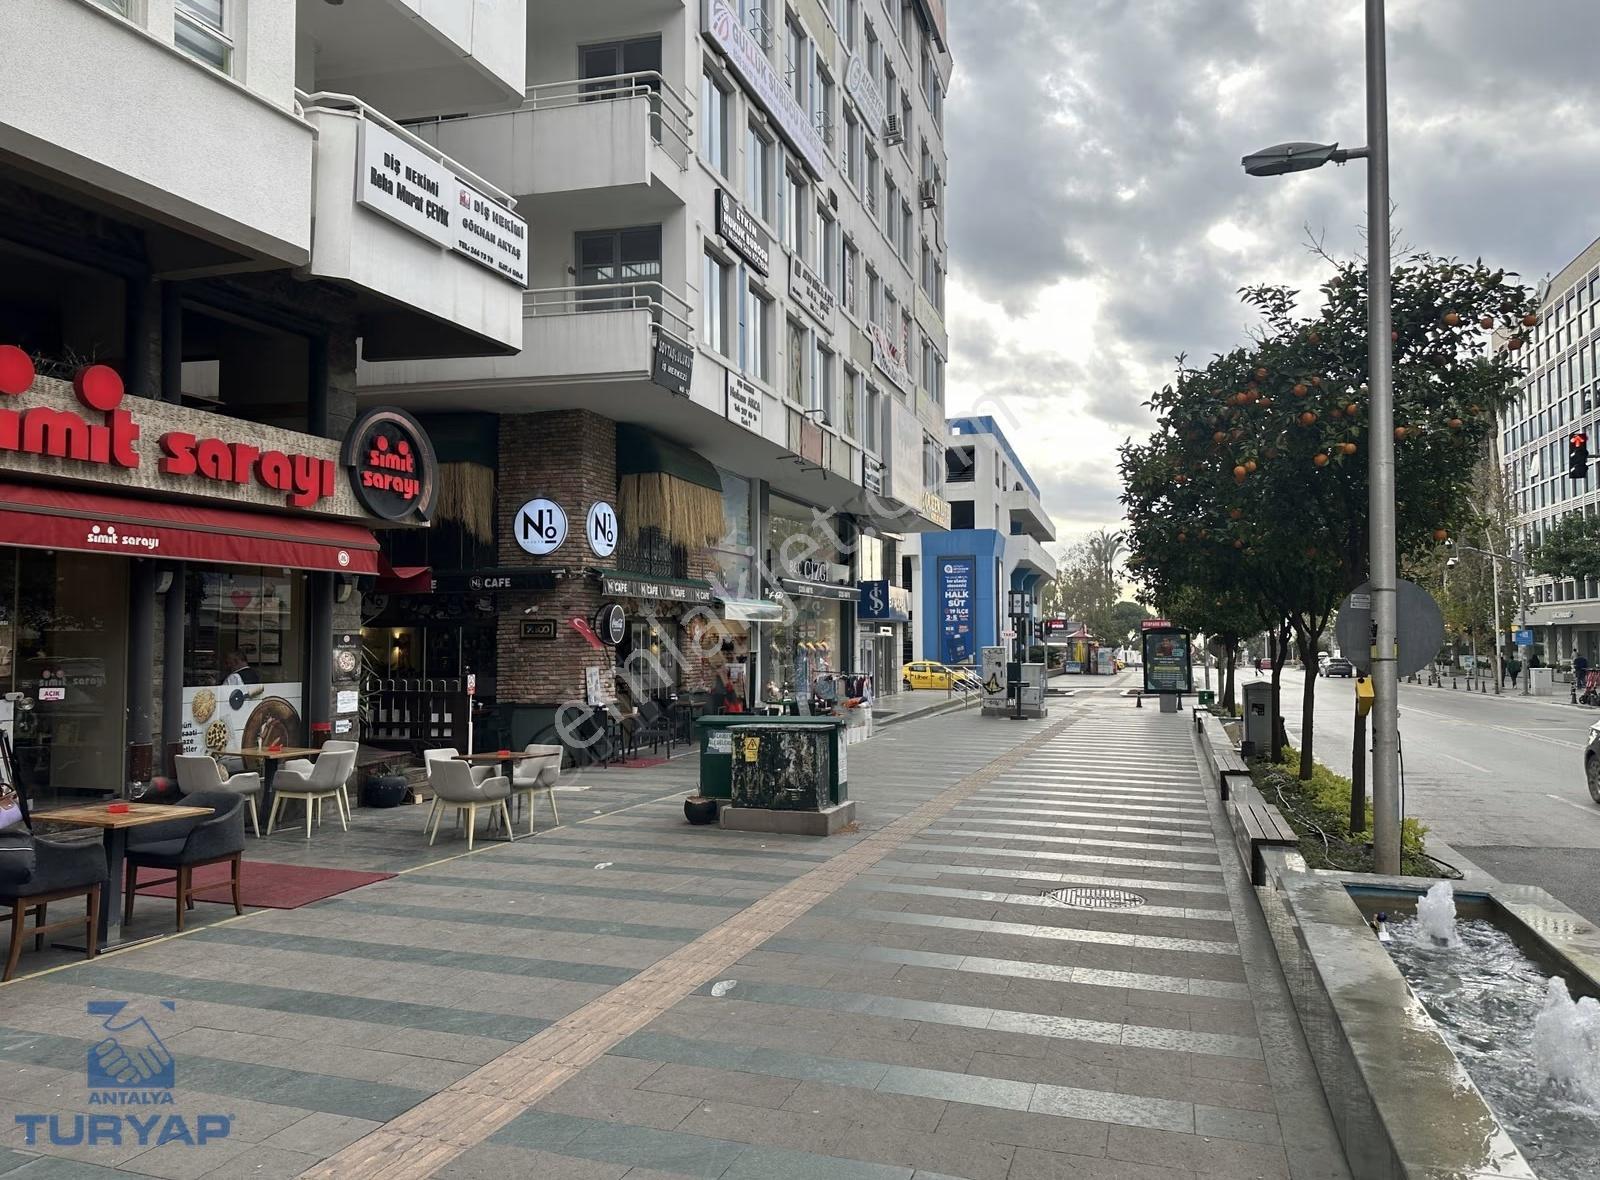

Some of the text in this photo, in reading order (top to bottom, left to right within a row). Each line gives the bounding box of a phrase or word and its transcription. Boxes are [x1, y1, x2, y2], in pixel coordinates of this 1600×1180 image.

[384, 152, 439, 197] DİŞ HEKİMİ
[370, 166, 393, 195] Reha
[397, 182, 423, 212] Murat
[426, 199, 449, 227] ÇEVİK
[474, 198, 490, 221] DİŞ
[492, 211, 524, 239] HEKİMİ
[723, 211, 745, 241] HUKUK
[737, 208, 757, 237] ETKİN
[462, 217, 521, 260] GÖKHAN AKTAŞ
[667, 365, 687, 381] MERKEZİ
[0, 345, 335, 507] imit sarayı
[369, 435, 414, 473] simit
[363, 470, 420, 499] sarayı
[87, 525, 159, 550] simit sarayı
[484, 577, 511, 588] CAFE
[614, 582, 628, 593] CAFE
[647, 584, 659, 596] CAFE
[674, 589, 686, 598] CAFE
[944, 590, 969, 598] HALK
[948, 598, 966, 607] SÜT
